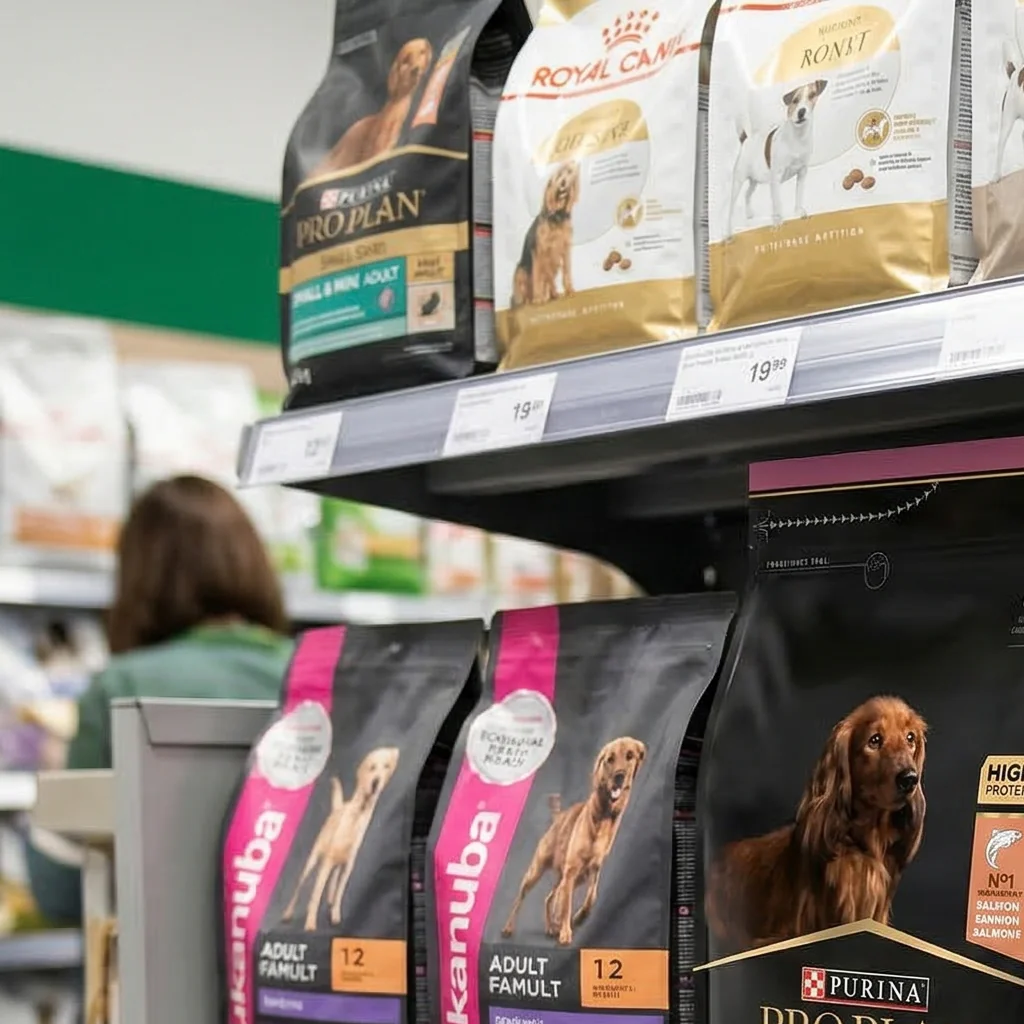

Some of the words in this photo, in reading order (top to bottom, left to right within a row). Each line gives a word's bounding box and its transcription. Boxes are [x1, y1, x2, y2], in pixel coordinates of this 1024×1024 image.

[531, 58, 610, 88] ROYAL
[297, 211, 344, 247] PRO
[345, 189, 421, 234] PLAN
[260, 941, 308, 961] ADULT
[341, 947, 364, 966] 12
[489, 955, 548, 976] ADULT
[594, 959, 623, 980] 12
[489, 976, 561, 998] FAMULT
[830, 975, 921, 1004] PURINA
